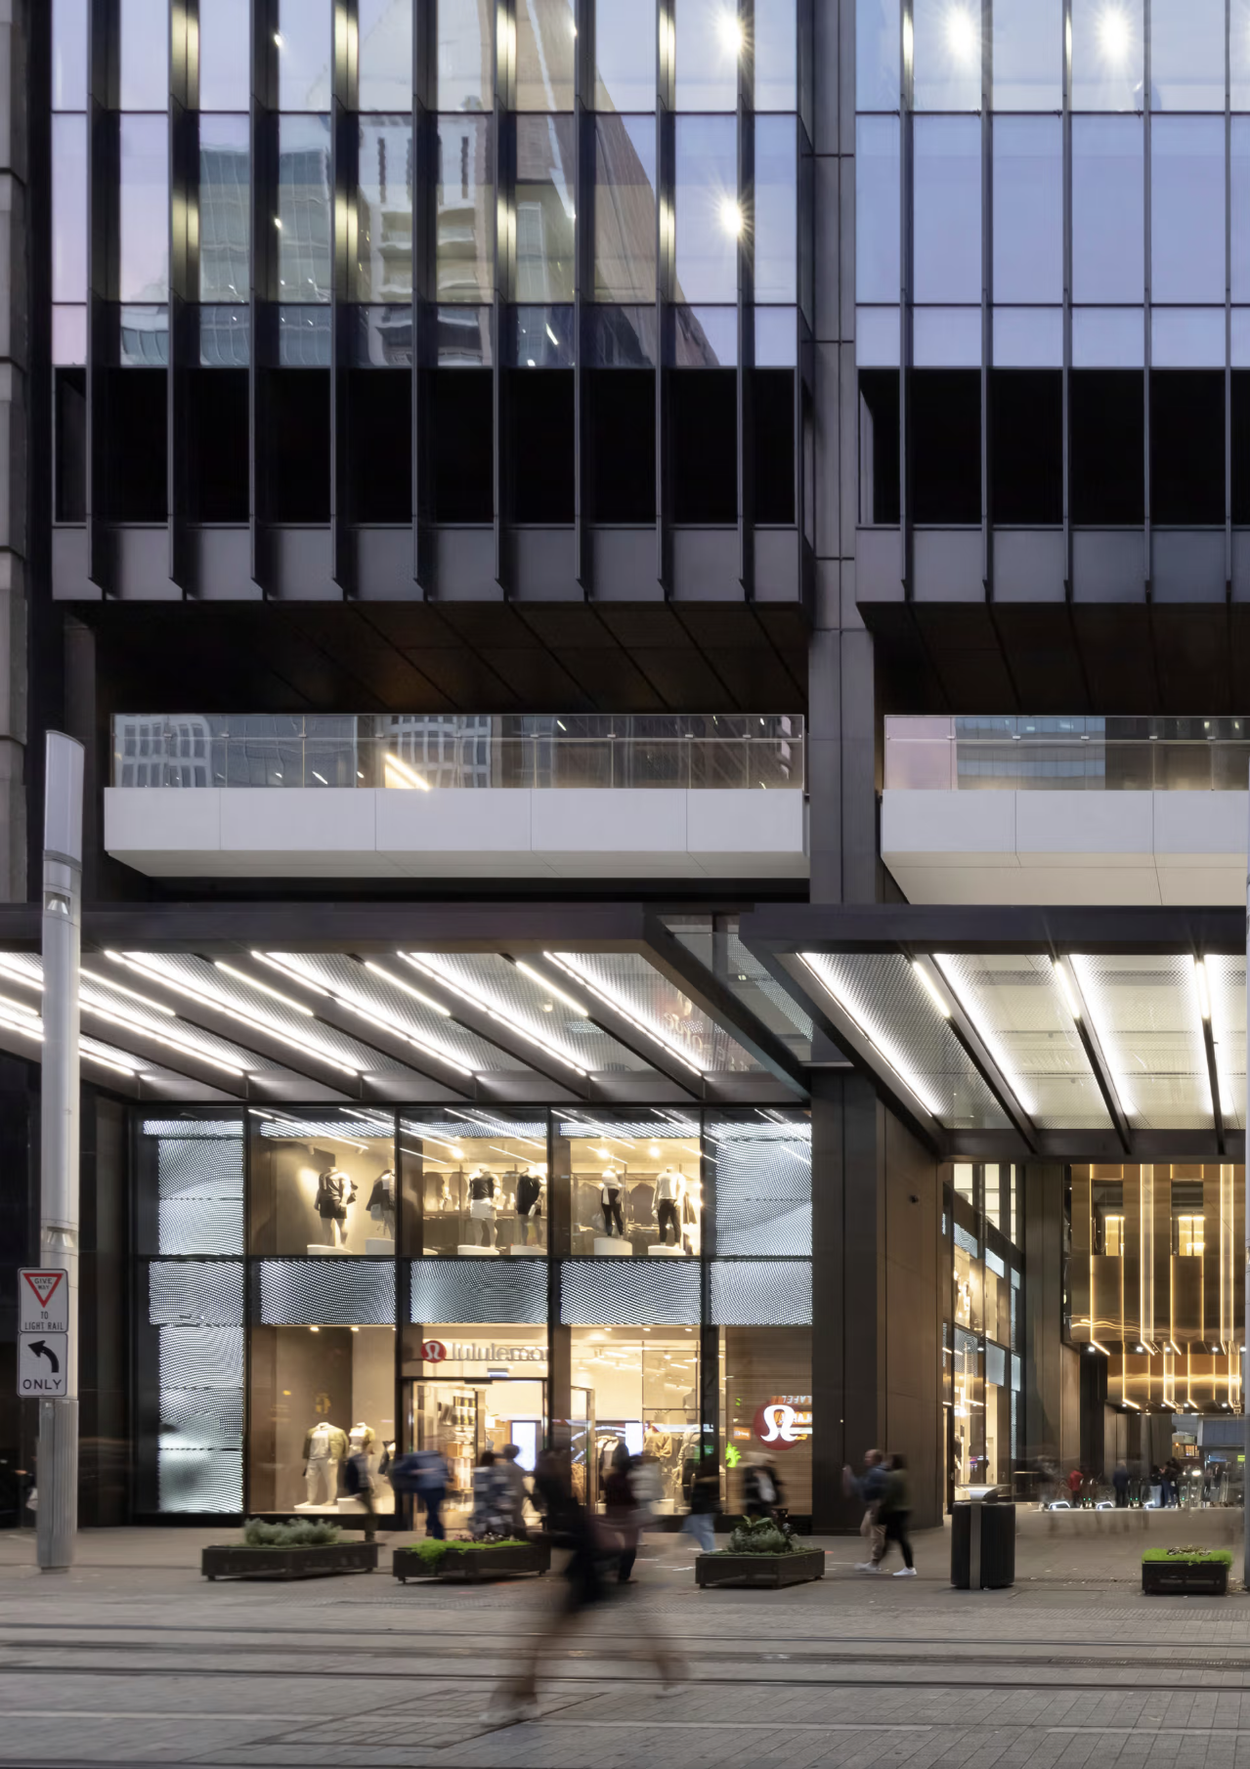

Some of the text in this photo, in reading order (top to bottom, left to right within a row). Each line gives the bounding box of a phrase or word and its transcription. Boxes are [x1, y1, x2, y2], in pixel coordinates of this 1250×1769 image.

[34, 1277, 52, 1285] GIVE
[40, 1311, 49, 1320] TO
[24, 1322, 64, 1330] LIGHT RAIL
[452, 1343, 548, 1361] lululemo
[22, 1379, 62, 1390] ONLY
